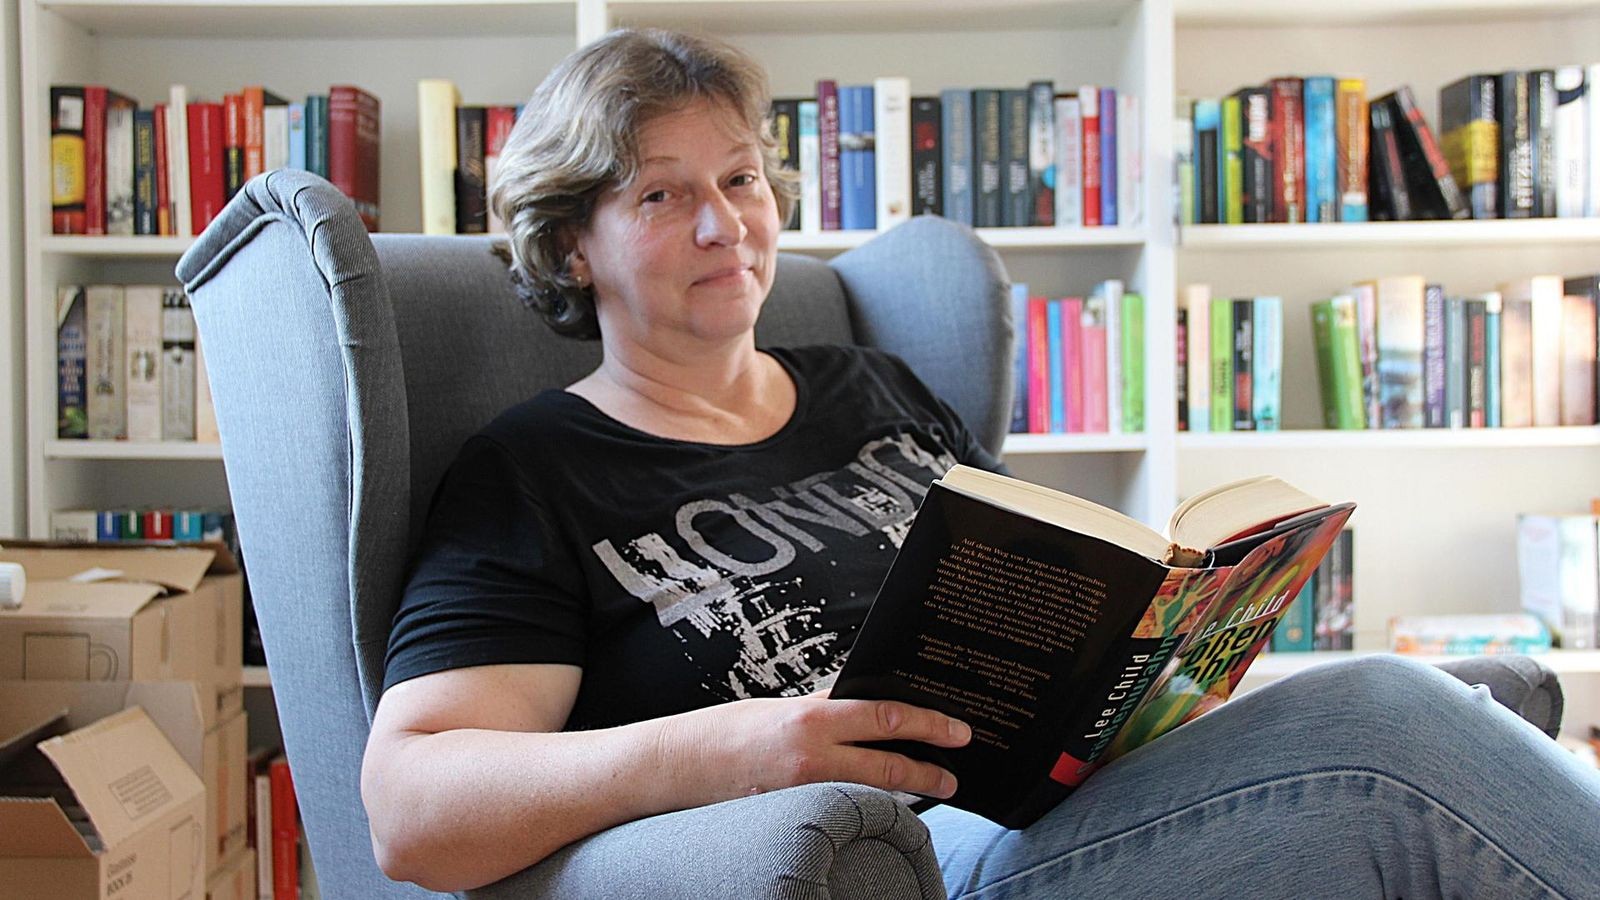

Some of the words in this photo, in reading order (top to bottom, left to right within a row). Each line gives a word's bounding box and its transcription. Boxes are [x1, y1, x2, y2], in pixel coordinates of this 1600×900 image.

[1226, 590, 1290, 628] Child
[1084, 706, 1117, 739] Lee
[1108, 654, 1150, 702] Child
